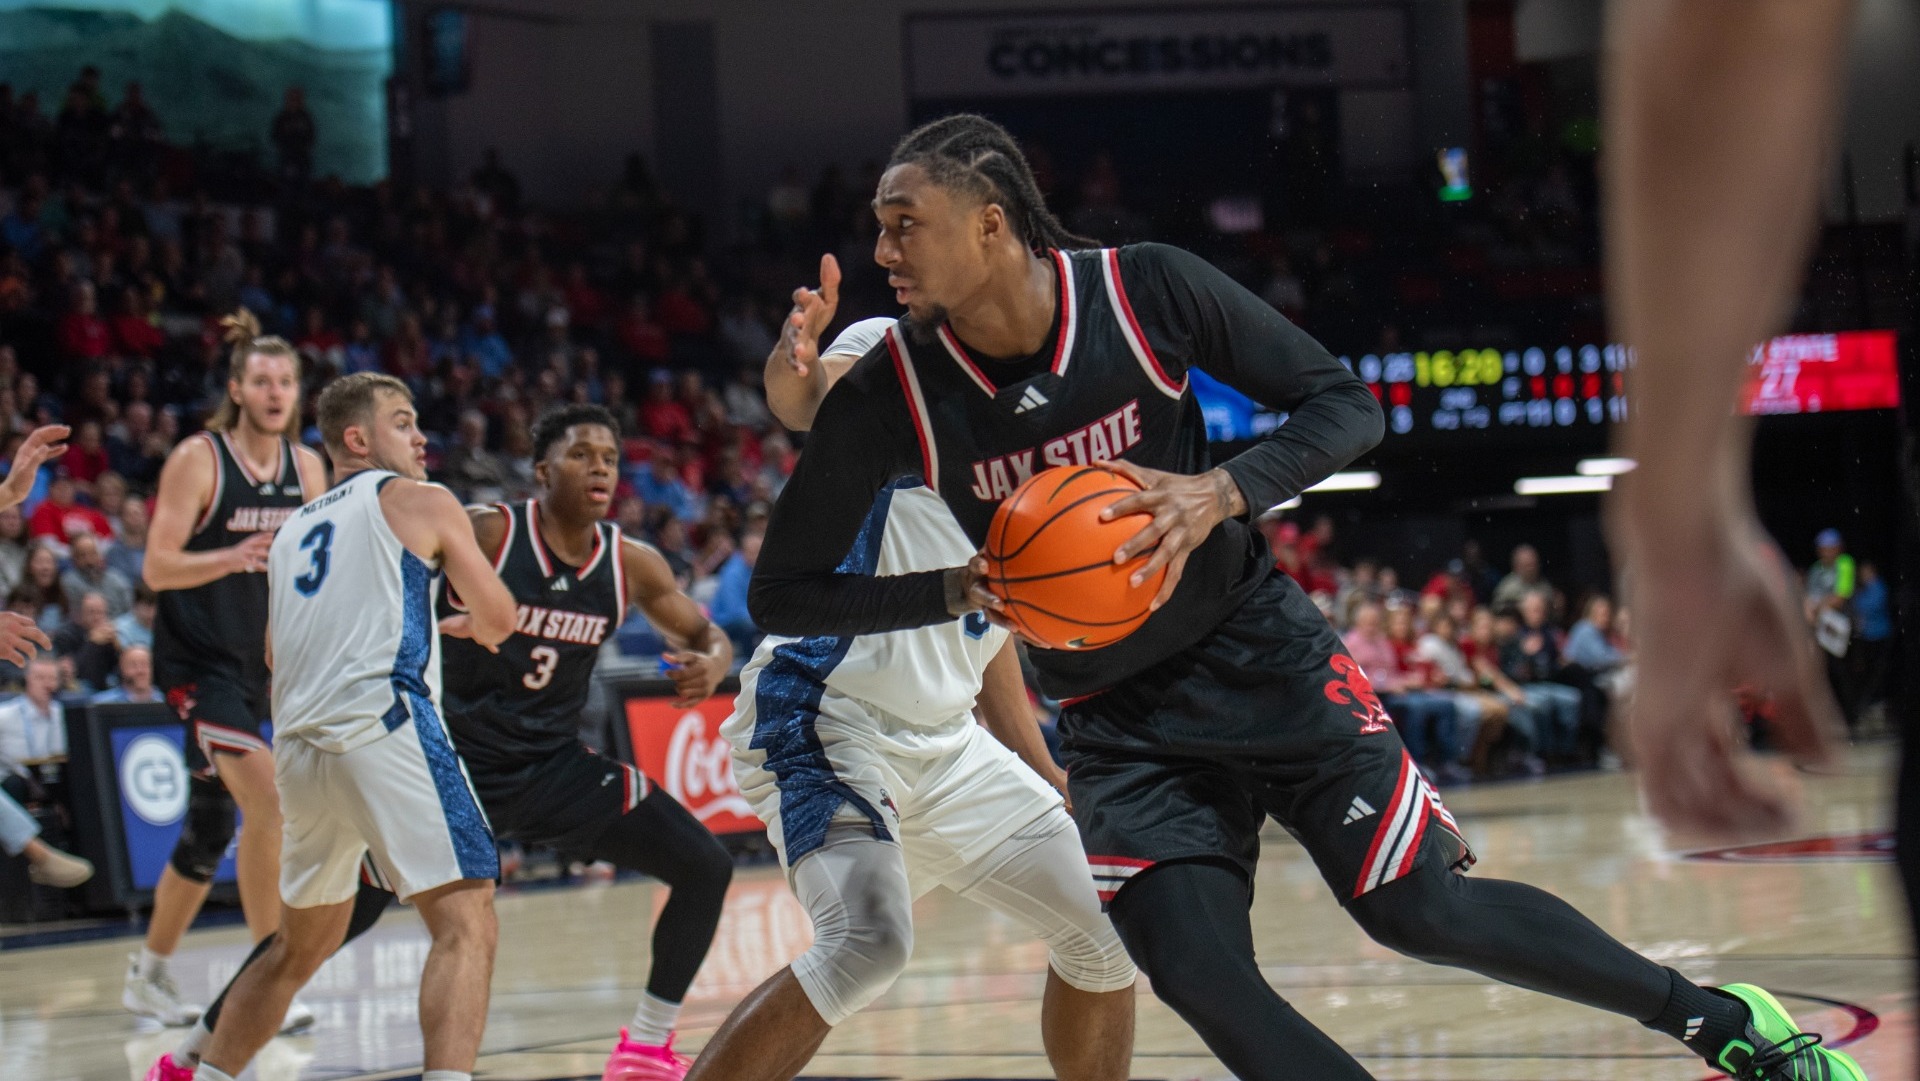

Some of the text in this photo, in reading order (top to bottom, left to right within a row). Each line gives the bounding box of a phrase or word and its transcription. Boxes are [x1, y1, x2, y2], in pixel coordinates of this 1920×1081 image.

[986, 34, 1333, 77] CONCESSIONS
[971, 447, 1037, 503] JAX
[1042, 399, 1143, 467] STATE
[293, 519, 335, 598] 3
[514, 603, 610, 647] AX STATE
[522, 645, 560, 691] 3
